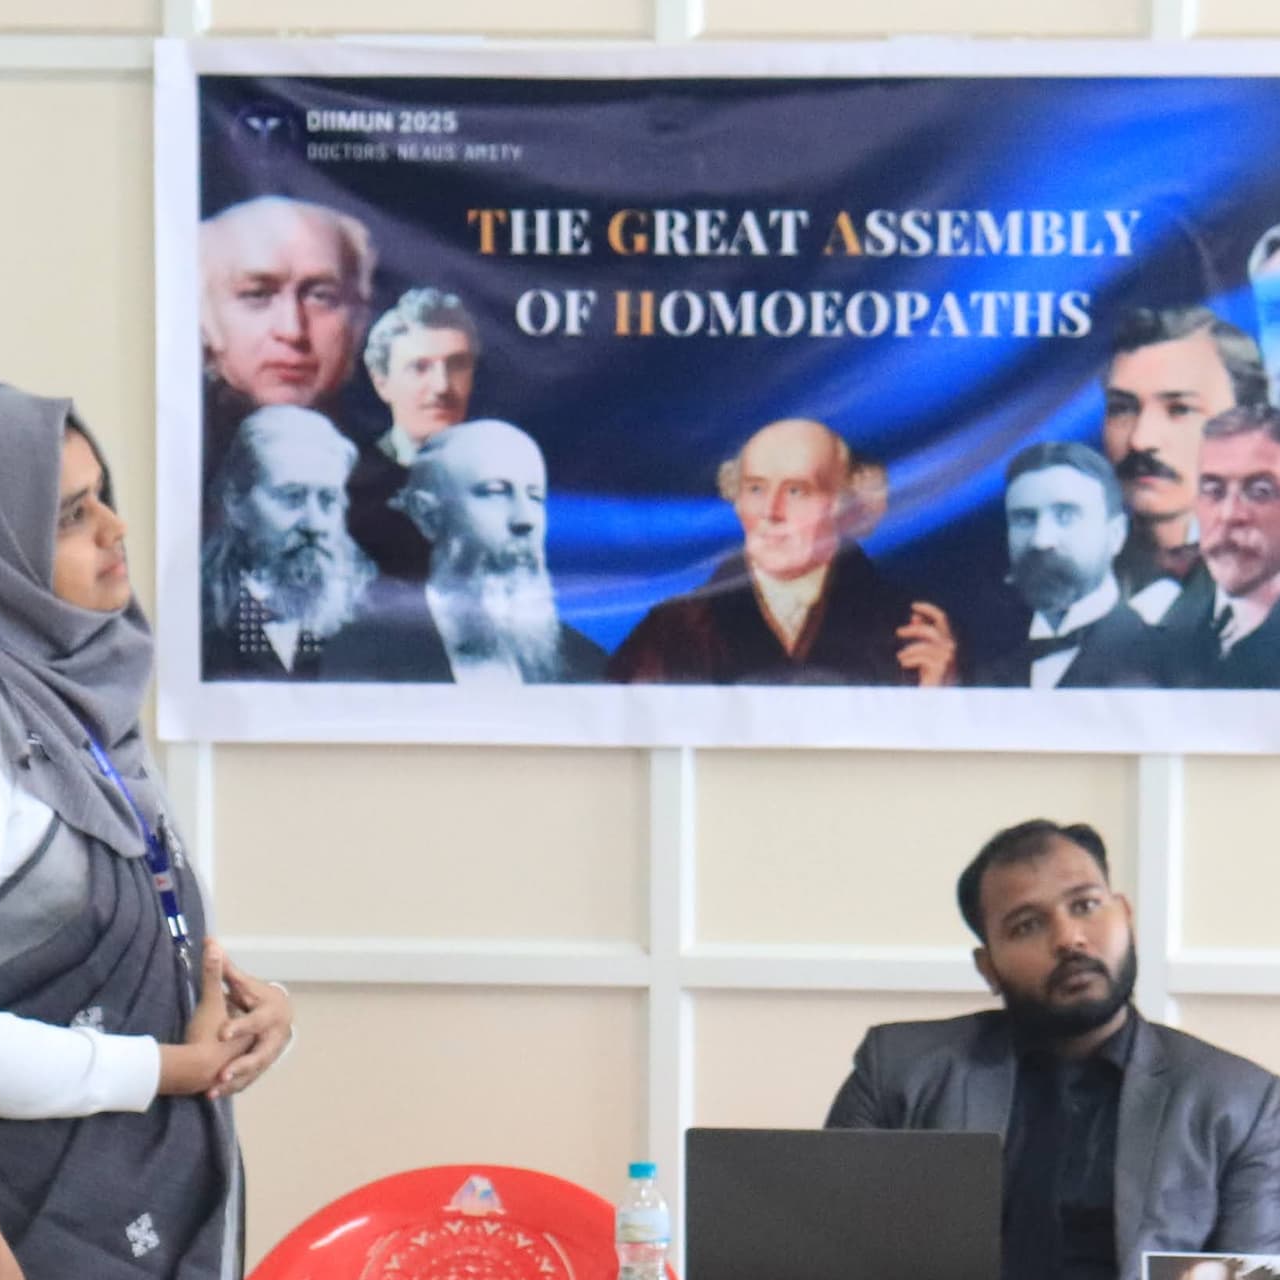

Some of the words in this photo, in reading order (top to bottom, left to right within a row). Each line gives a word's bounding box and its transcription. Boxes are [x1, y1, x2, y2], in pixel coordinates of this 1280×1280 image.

[306, 110, 394, 132] DIIMUN
[399, 111, 458, 133] 2025
[307, 143, 389, 161] DOCTORS
[464, 143, 523, 161] AMITY
[467, 209, 591, 256] THE
[608, 209, 810, 256] GREAT
[824, 209, 1141, 256] ASSEMBLY
[515, 290, 597, 337] OF
[614, 290, 1092, 338] HOMOEOPATHS
